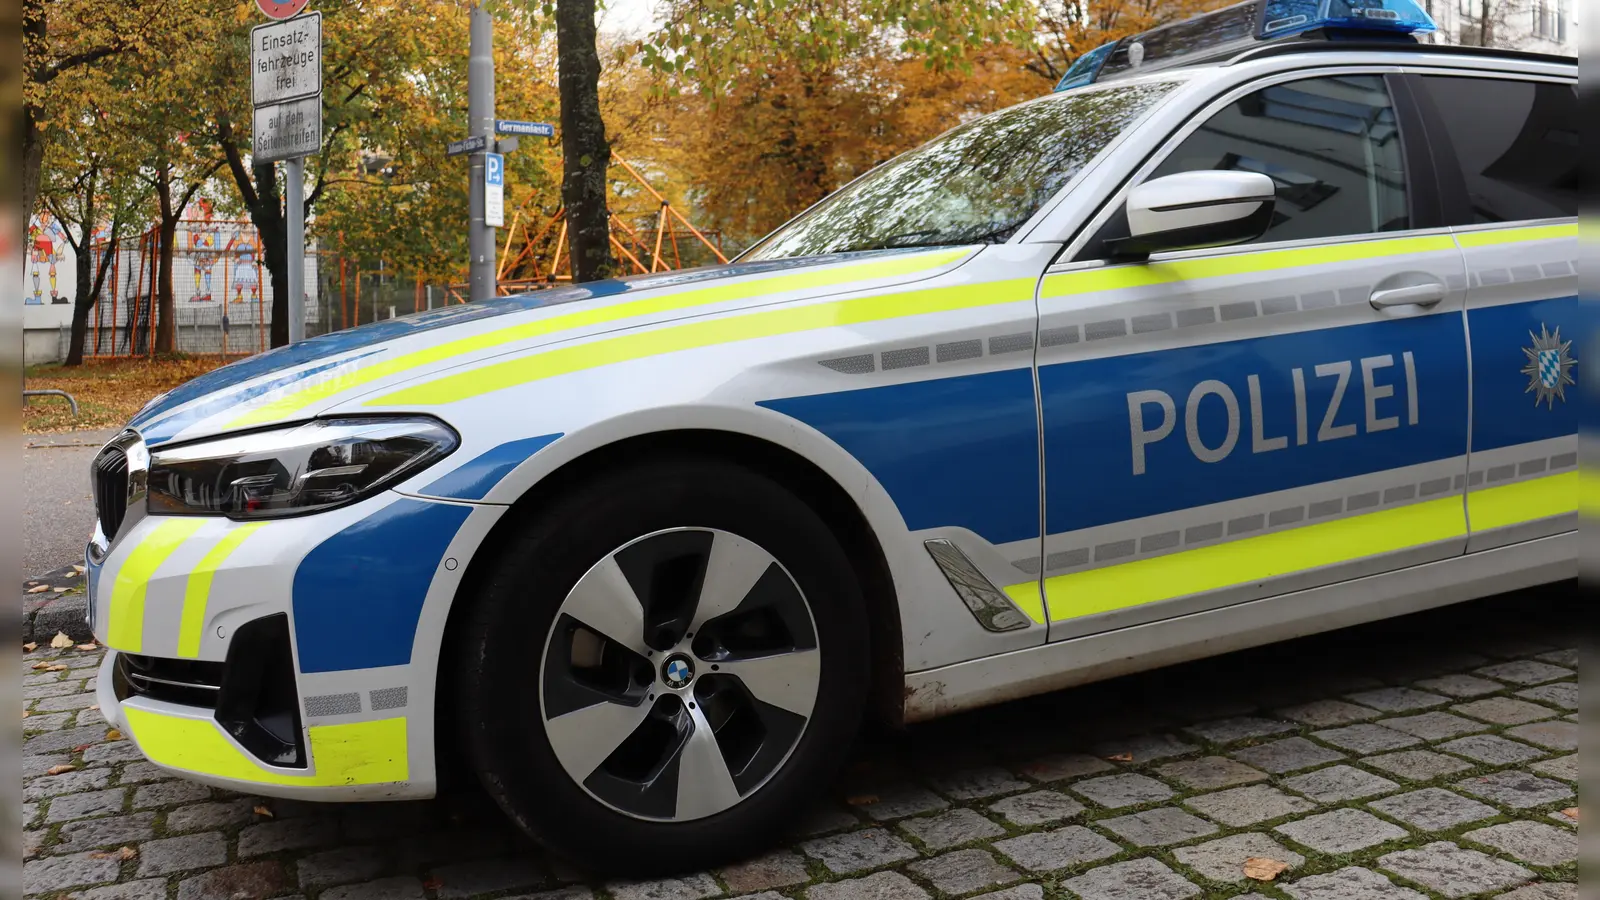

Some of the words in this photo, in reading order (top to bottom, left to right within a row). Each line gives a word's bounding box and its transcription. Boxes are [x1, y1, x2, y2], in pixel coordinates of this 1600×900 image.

[262, 31, 309, 51] Einsatz-
[257, 50, 314, 74] fahrzeuge
[276, 72, 295, 91] frei
[268, 114, 282, 129] auf
[285, 110, 304, 127] dem
[499, 121, 550, 135] Germaniastr.
[258, 127, 315, 152] Seitenstreifen
[488, 157, 498, 182] P
[1126, 351, 1419, 476] POLIZEI
